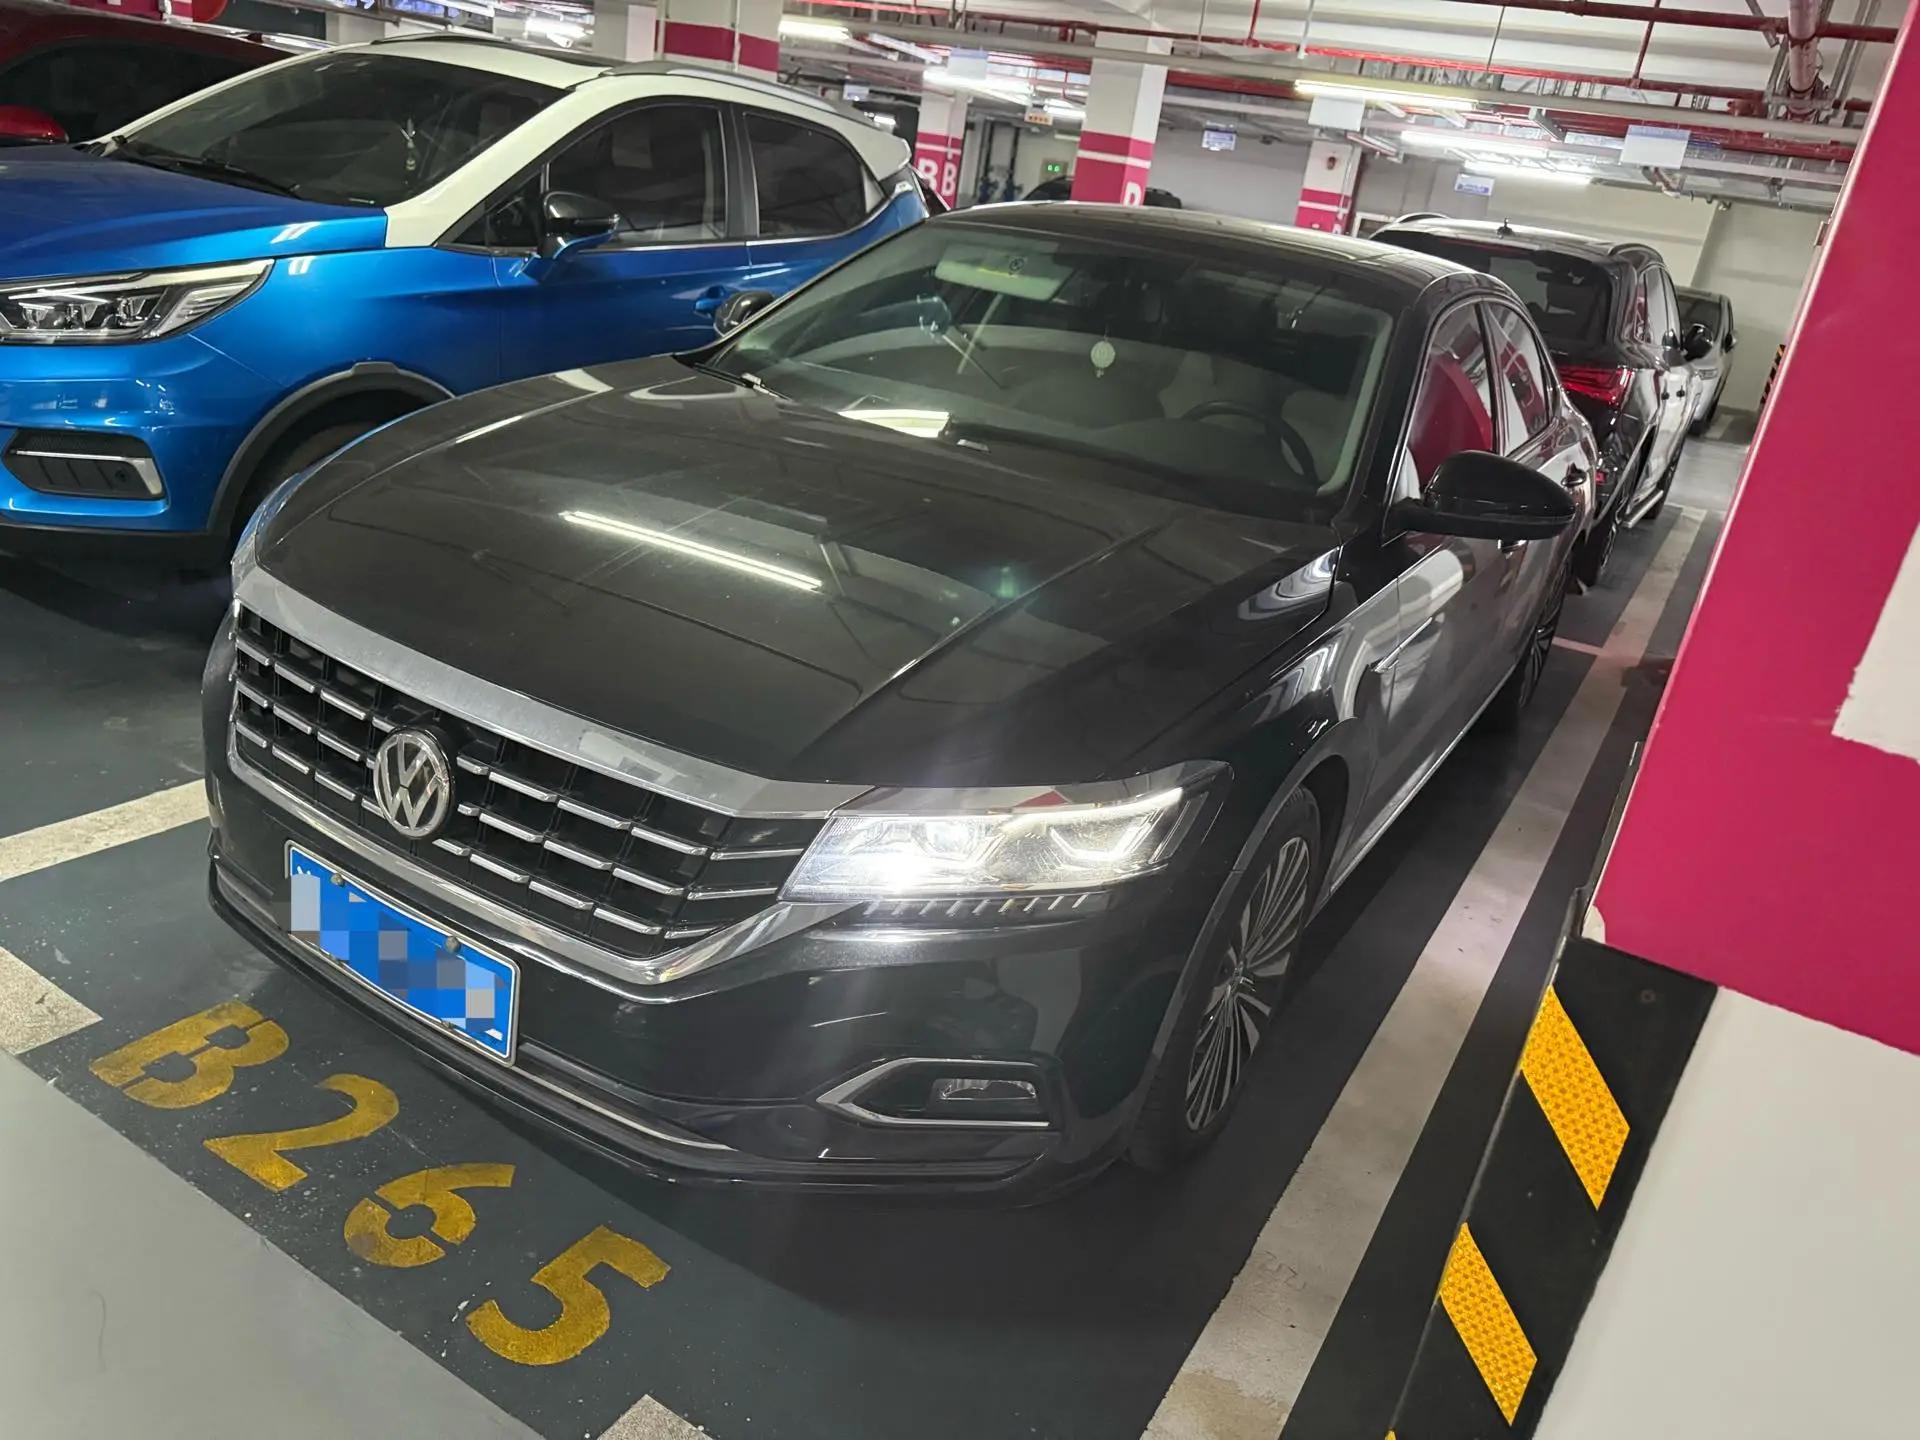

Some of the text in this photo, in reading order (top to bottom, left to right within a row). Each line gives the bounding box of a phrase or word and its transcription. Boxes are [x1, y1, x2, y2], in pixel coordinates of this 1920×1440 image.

[941, 161, 958, 197] B
[375, 732, 450, 837] VW
[88, 999, 672, 1367] B265
